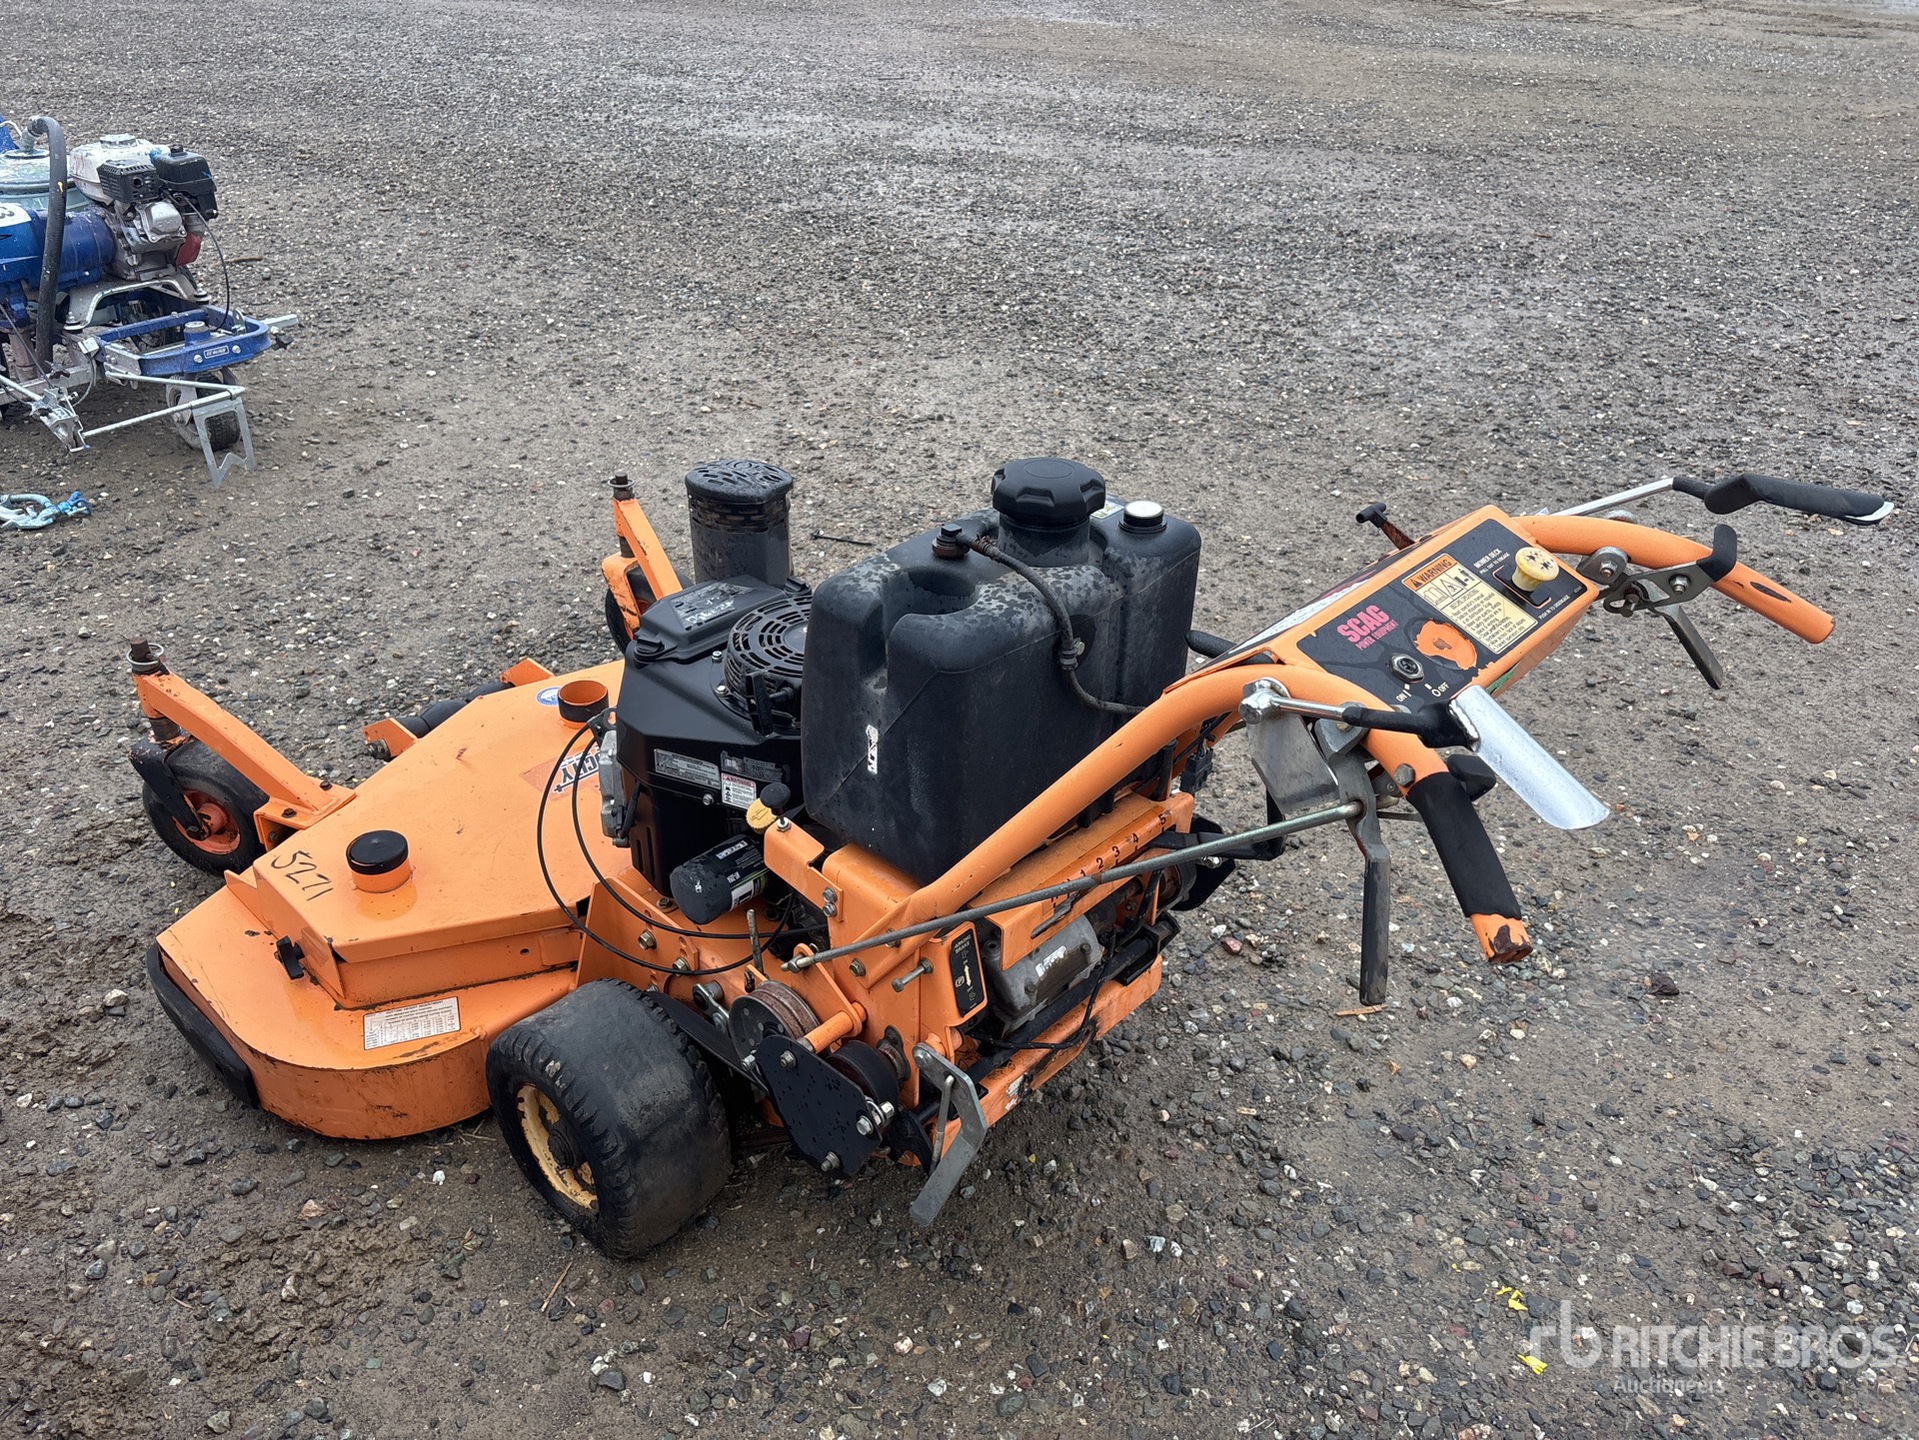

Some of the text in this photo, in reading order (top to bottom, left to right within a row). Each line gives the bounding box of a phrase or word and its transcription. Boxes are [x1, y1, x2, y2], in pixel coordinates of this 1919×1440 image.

[1416, 558, 1452, 583] WARNING
[1473, 548, 1502, 569] MOWER DECK
[1337, 605, 1389, 643] SCAG
[1355, 619, 1399, 651] POWER EQUIPMENT
[1396, 692, 1407, 702] ON
[1438, 682, 1450, 693] OFF
[1096, 858, 1103, 869] 2
[1112, 846, 1119, 857] 3
[1133, 833, 1139, 843] 4
[1159, 814, 1166, 824] 5
[271, 850, 334, 901] 5271
